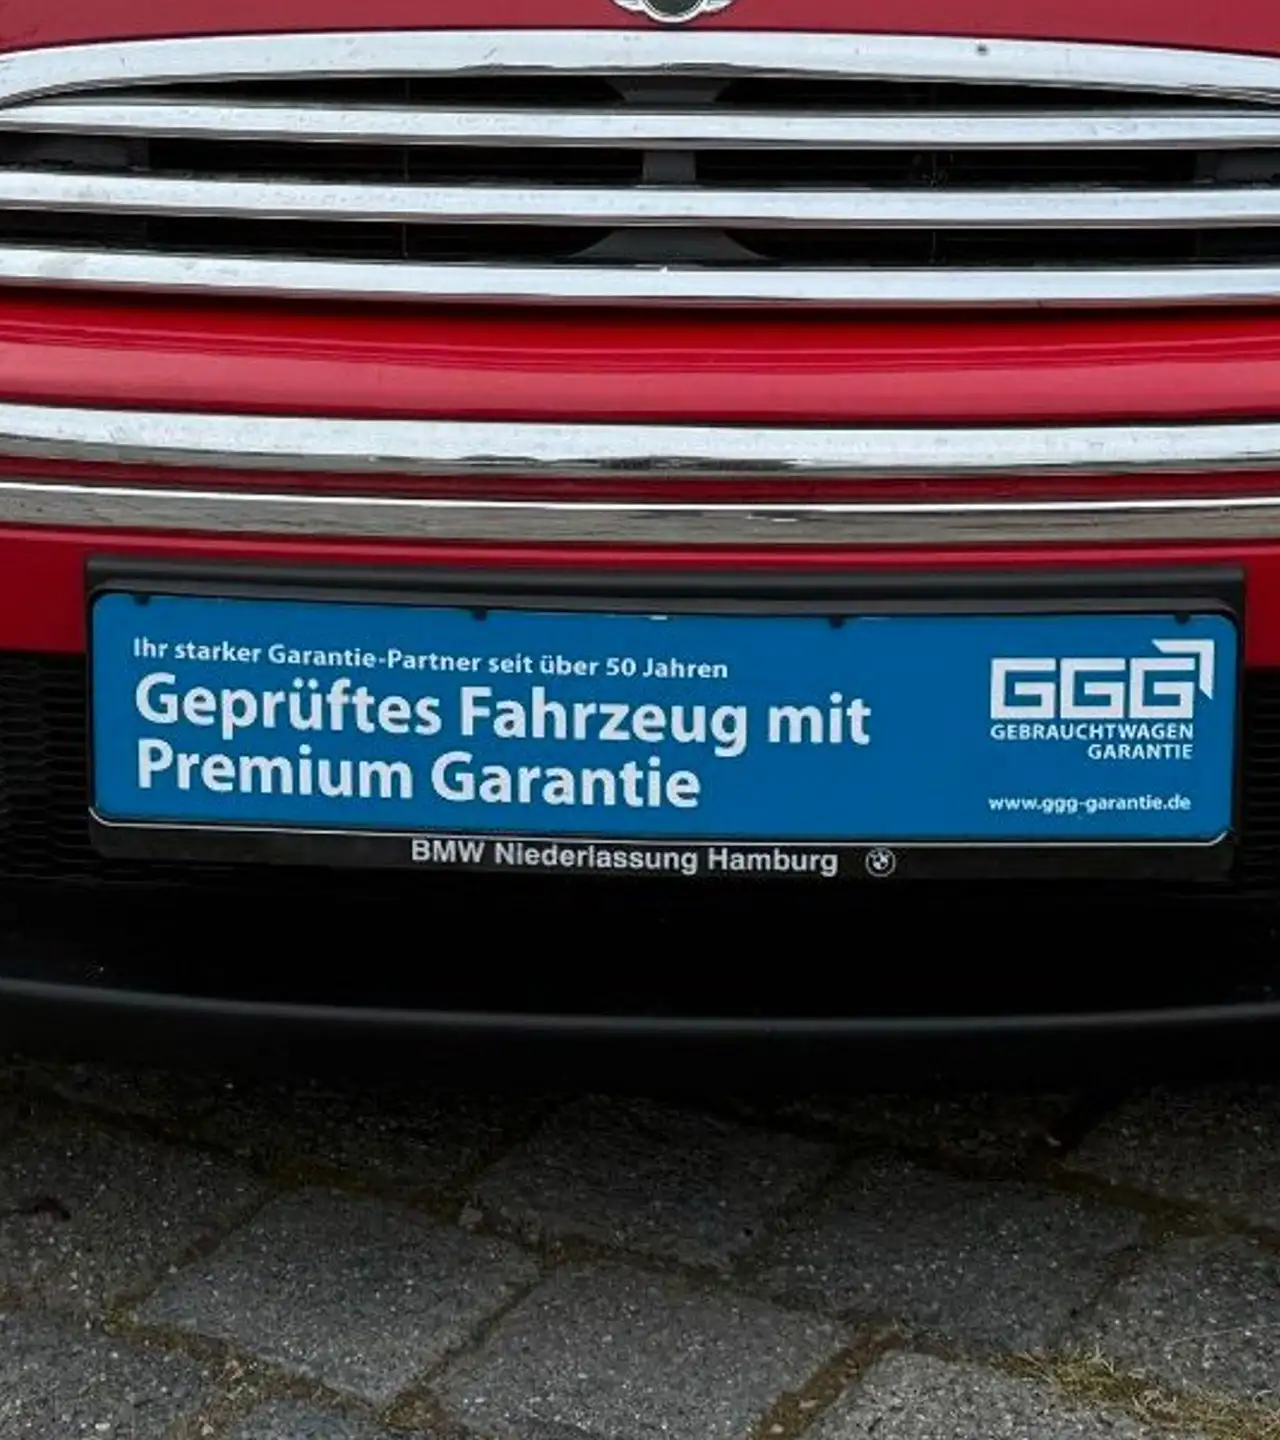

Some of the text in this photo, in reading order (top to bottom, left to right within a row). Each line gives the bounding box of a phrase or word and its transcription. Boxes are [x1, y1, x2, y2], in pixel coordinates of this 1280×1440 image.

[132, 636, 729, 679] Ihr starker Garantie-Partner seit über 50 Jahren
[989, 657, 1197, 720] GGG
[135, 671, 873, 758] Geprüftes Fahrzeug mit
[989, 722, 1195, 741] GEBRAUCHTWAGEN
[1086, 743, 1194, 760] GARANTIE
[137, 737, 702, 808] Premium Garantie
[987, 793, 1193, 814] www.ggg-garantie.de
[411, 839, 839, 877] BMW Niederlassung Hamburg
